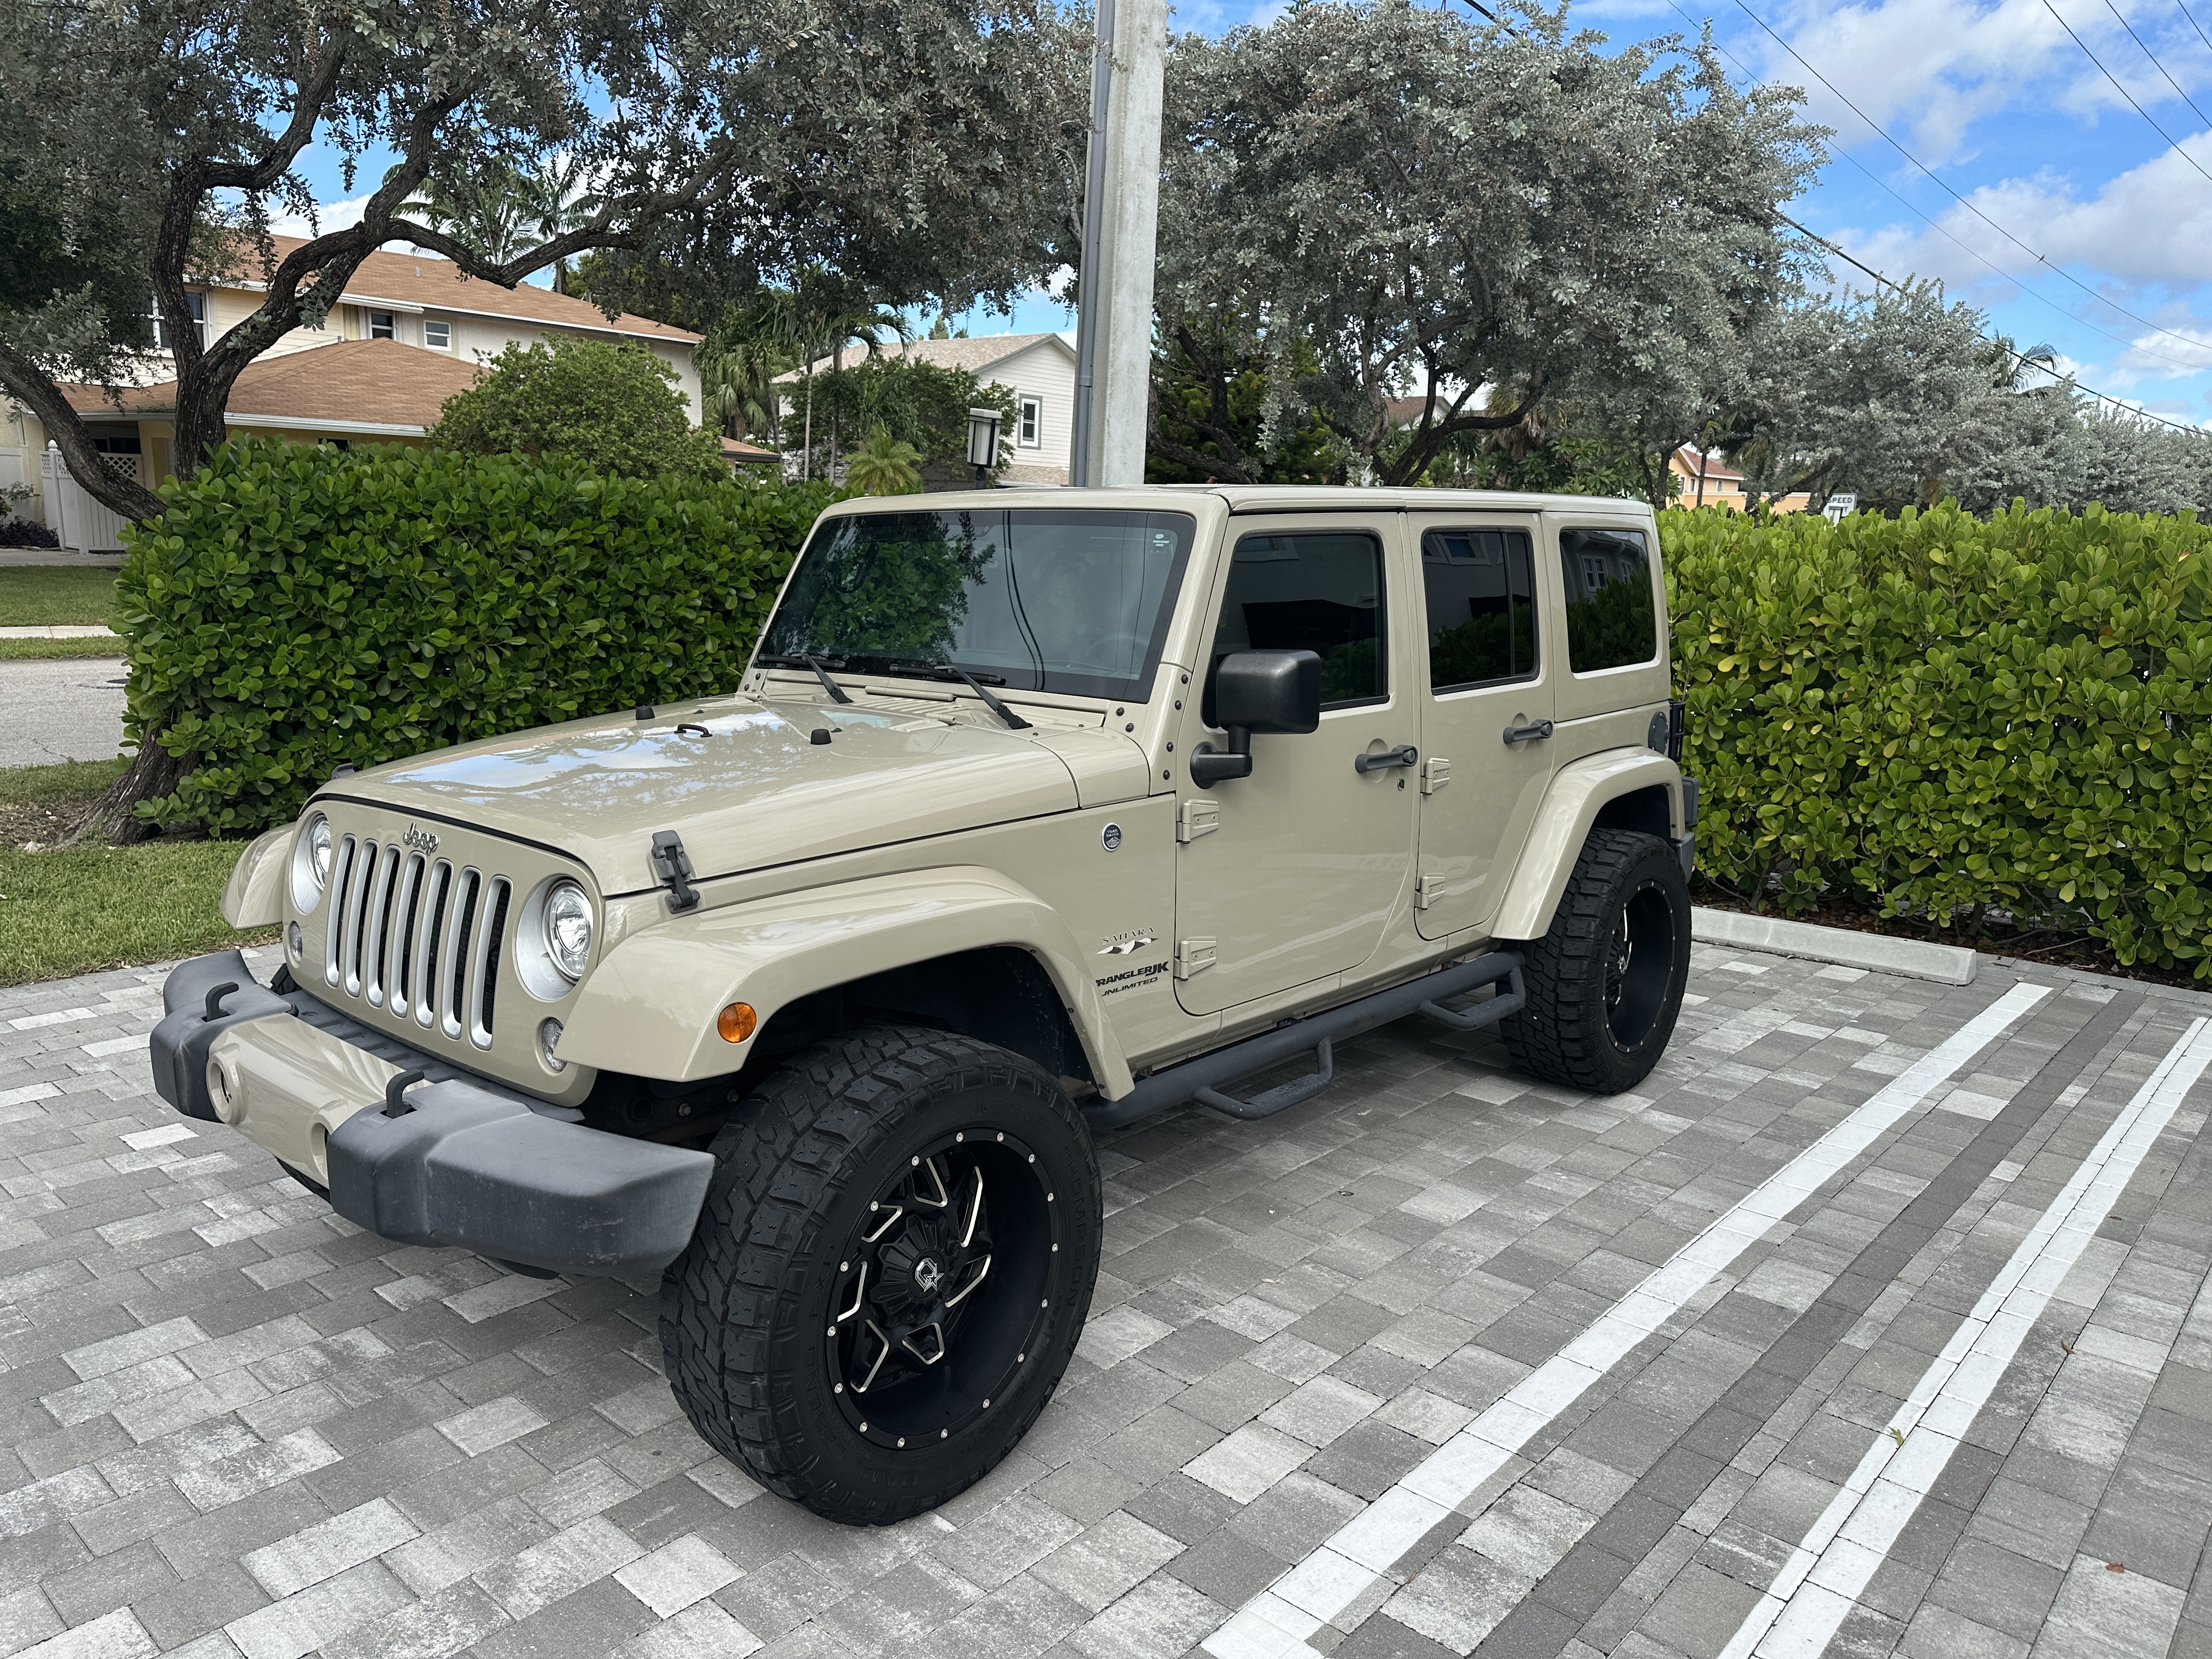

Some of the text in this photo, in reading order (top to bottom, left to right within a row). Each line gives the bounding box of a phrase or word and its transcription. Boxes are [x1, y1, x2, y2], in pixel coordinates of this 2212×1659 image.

[403, 822, 441, 856] Jeep
[1102, 926, 1155, 945] SAHARA
[974, 1097, 1087, 1308] MICKEY THOMPSON
[807, 1243, 836, 1319] EXP
[804, 1345, 848, 1462] LEGEND
